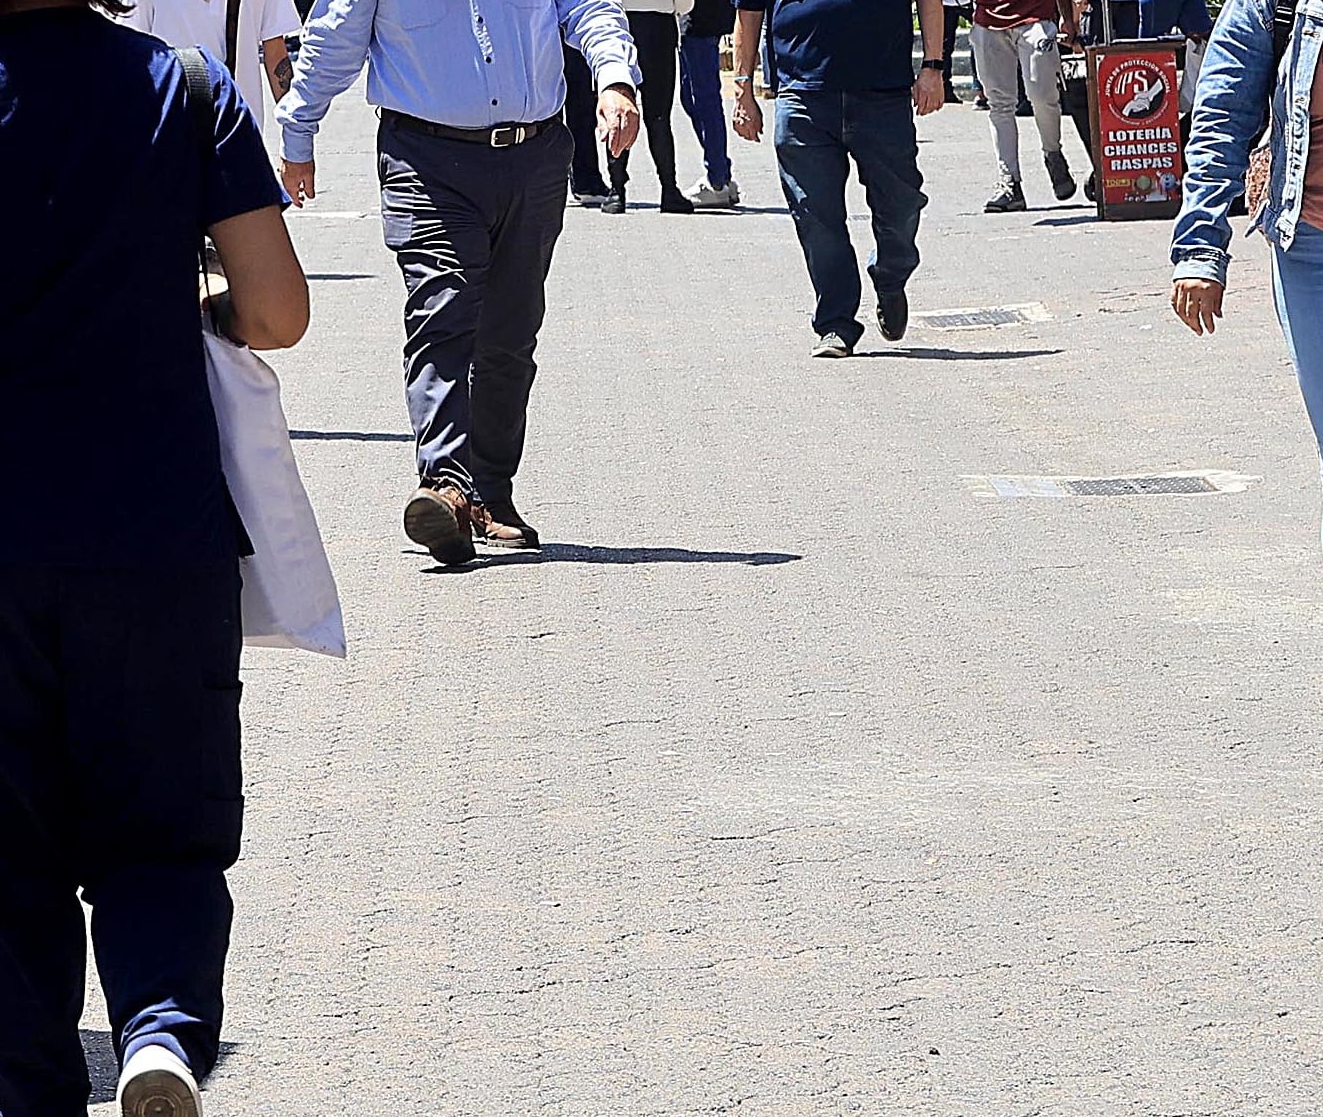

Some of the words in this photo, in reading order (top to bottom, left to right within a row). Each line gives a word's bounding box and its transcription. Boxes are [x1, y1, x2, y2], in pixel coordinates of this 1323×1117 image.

[1108, 126, 1172, 142] LOTERÍA
[1104, 141, 1178, 157] CHANCES
[1110, 156, 1173, 171] RASPAS
